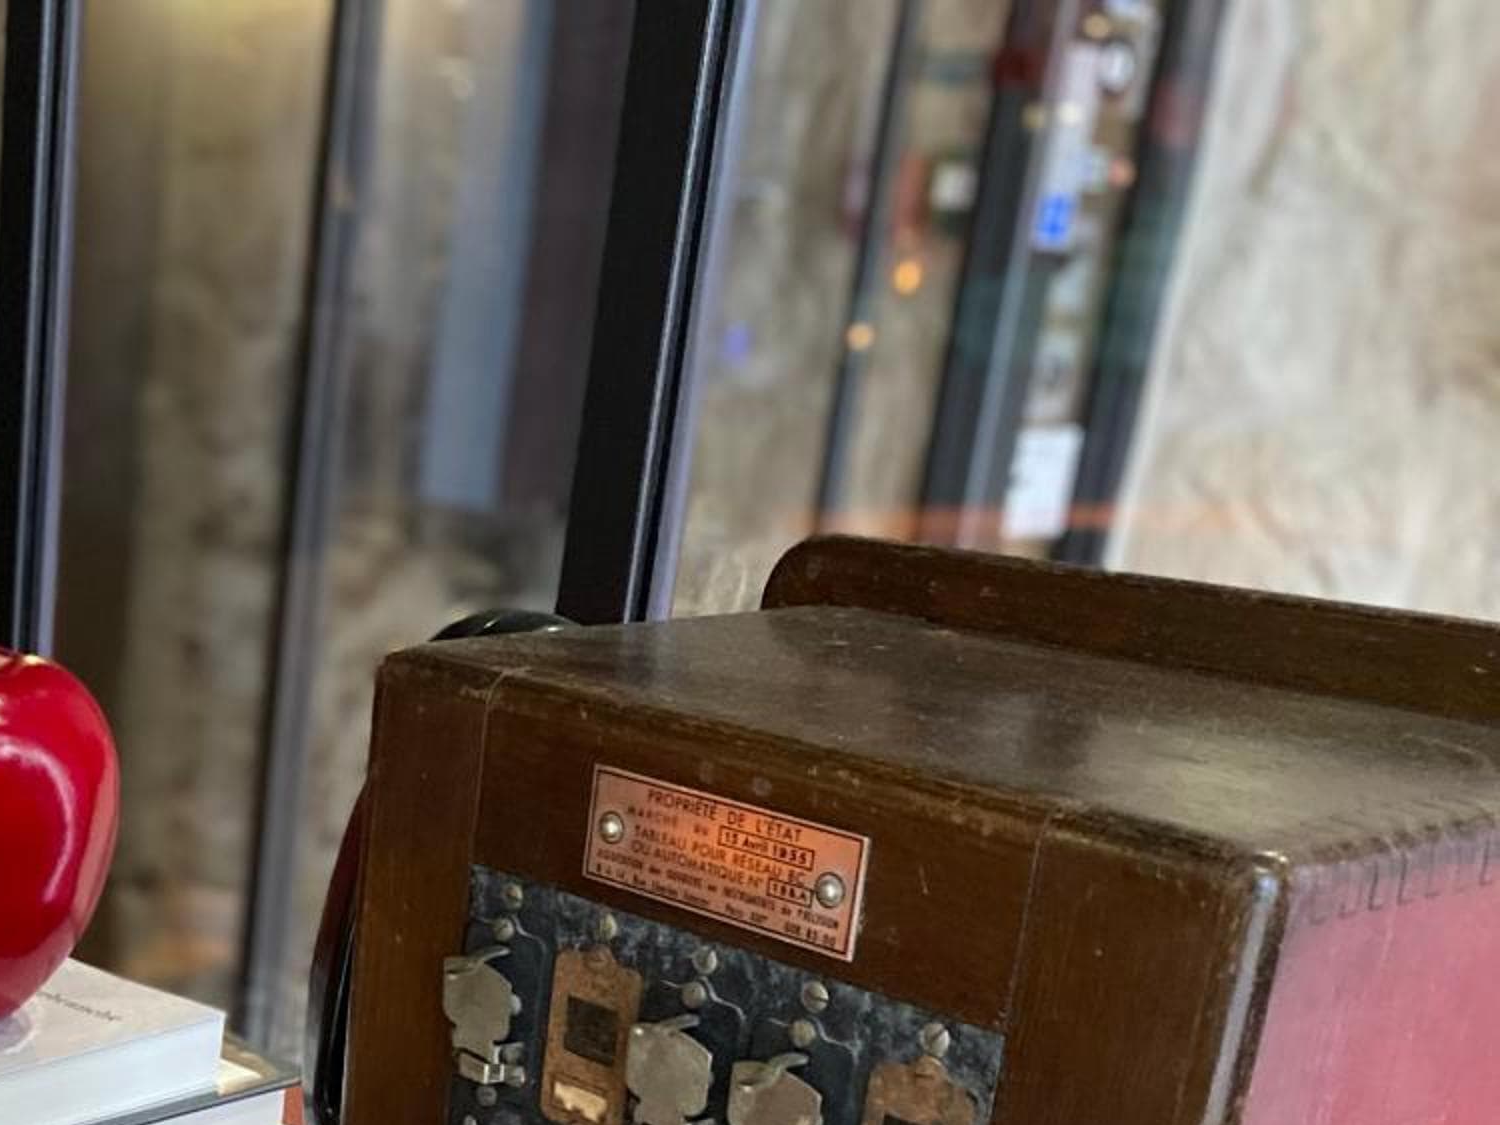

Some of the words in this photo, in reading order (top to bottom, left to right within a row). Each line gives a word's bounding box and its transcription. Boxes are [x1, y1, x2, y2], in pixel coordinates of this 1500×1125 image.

[727, 809, 745, 828] DE
[633, 823, 686, 851] TABLEAU
[691, 840, 727, 863] POUR
[653, 845, 745, 885] AUTOMATIQUE
